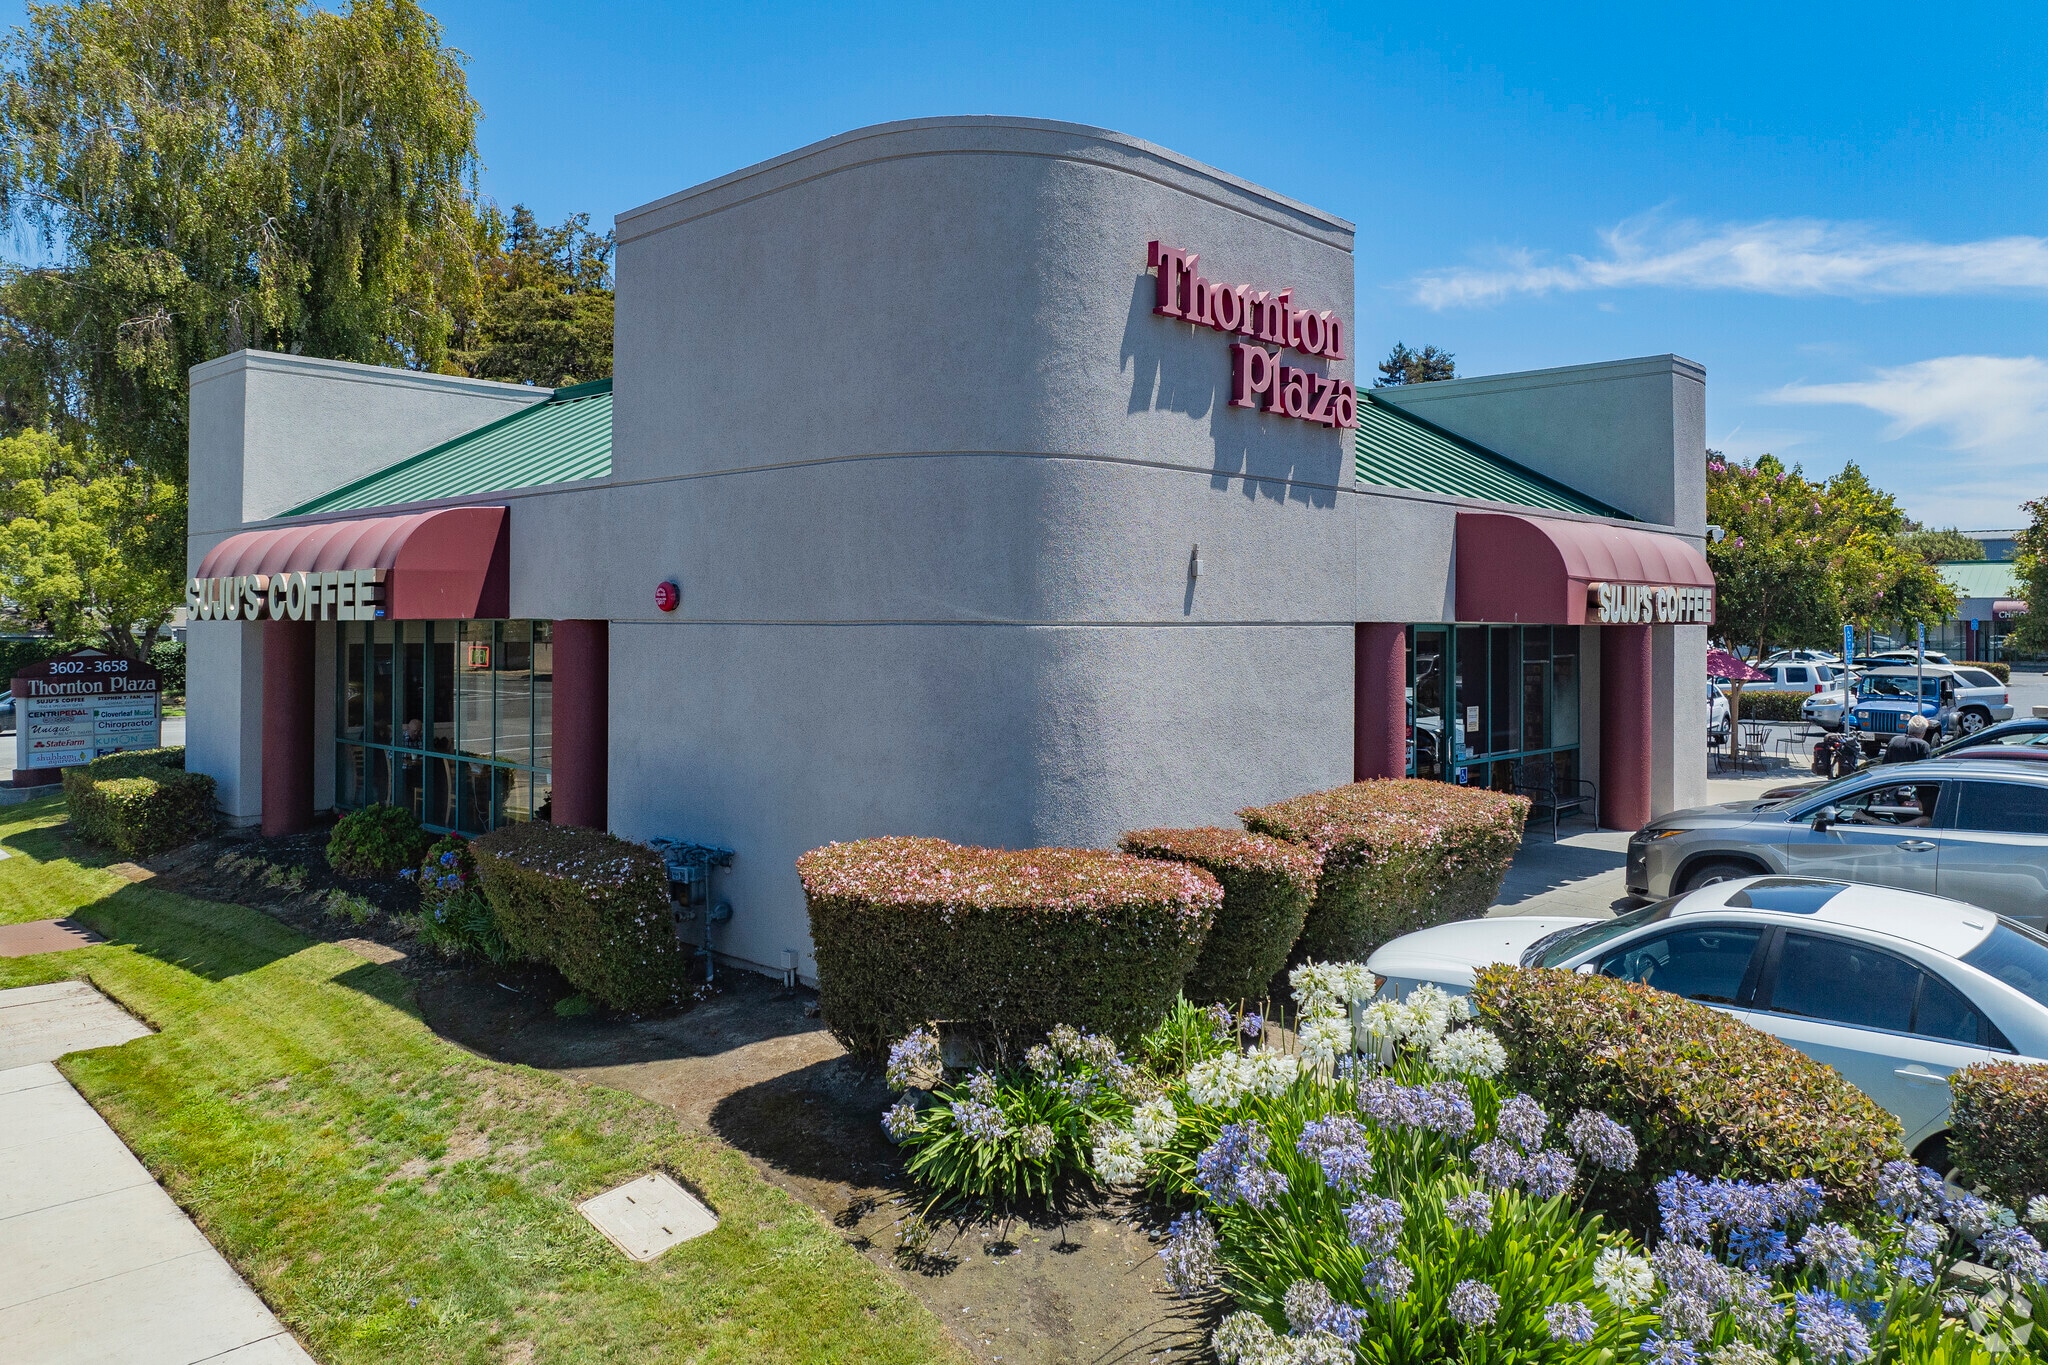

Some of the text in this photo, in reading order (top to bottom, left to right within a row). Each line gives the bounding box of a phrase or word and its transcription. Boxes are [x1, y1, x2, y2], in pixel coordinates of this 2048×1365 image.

[1148, 240, 1346, 360] Thornton
[1229, 342, 1361, 428] Plaza
[186, 568, 378, 621] SUJU'S COFFEE
[1597, 582, 1712, 623] SUJU'S COFFEE
[49, 661, 84, 675] 3602
[94, 660, 128, 672] 3658
[28, 676, 156, 696] Thornton Plaza
[28, 709, 88, 718] CENTRIPEDAL
[101, 710, 133, 718] Cloverleaf
[31, 725, 70, 735] Unique
[98, 720, 153, 729] Chiropractor
[95, 734, 137, 745] KUMON
[36, 753, 74, 761] shubham
